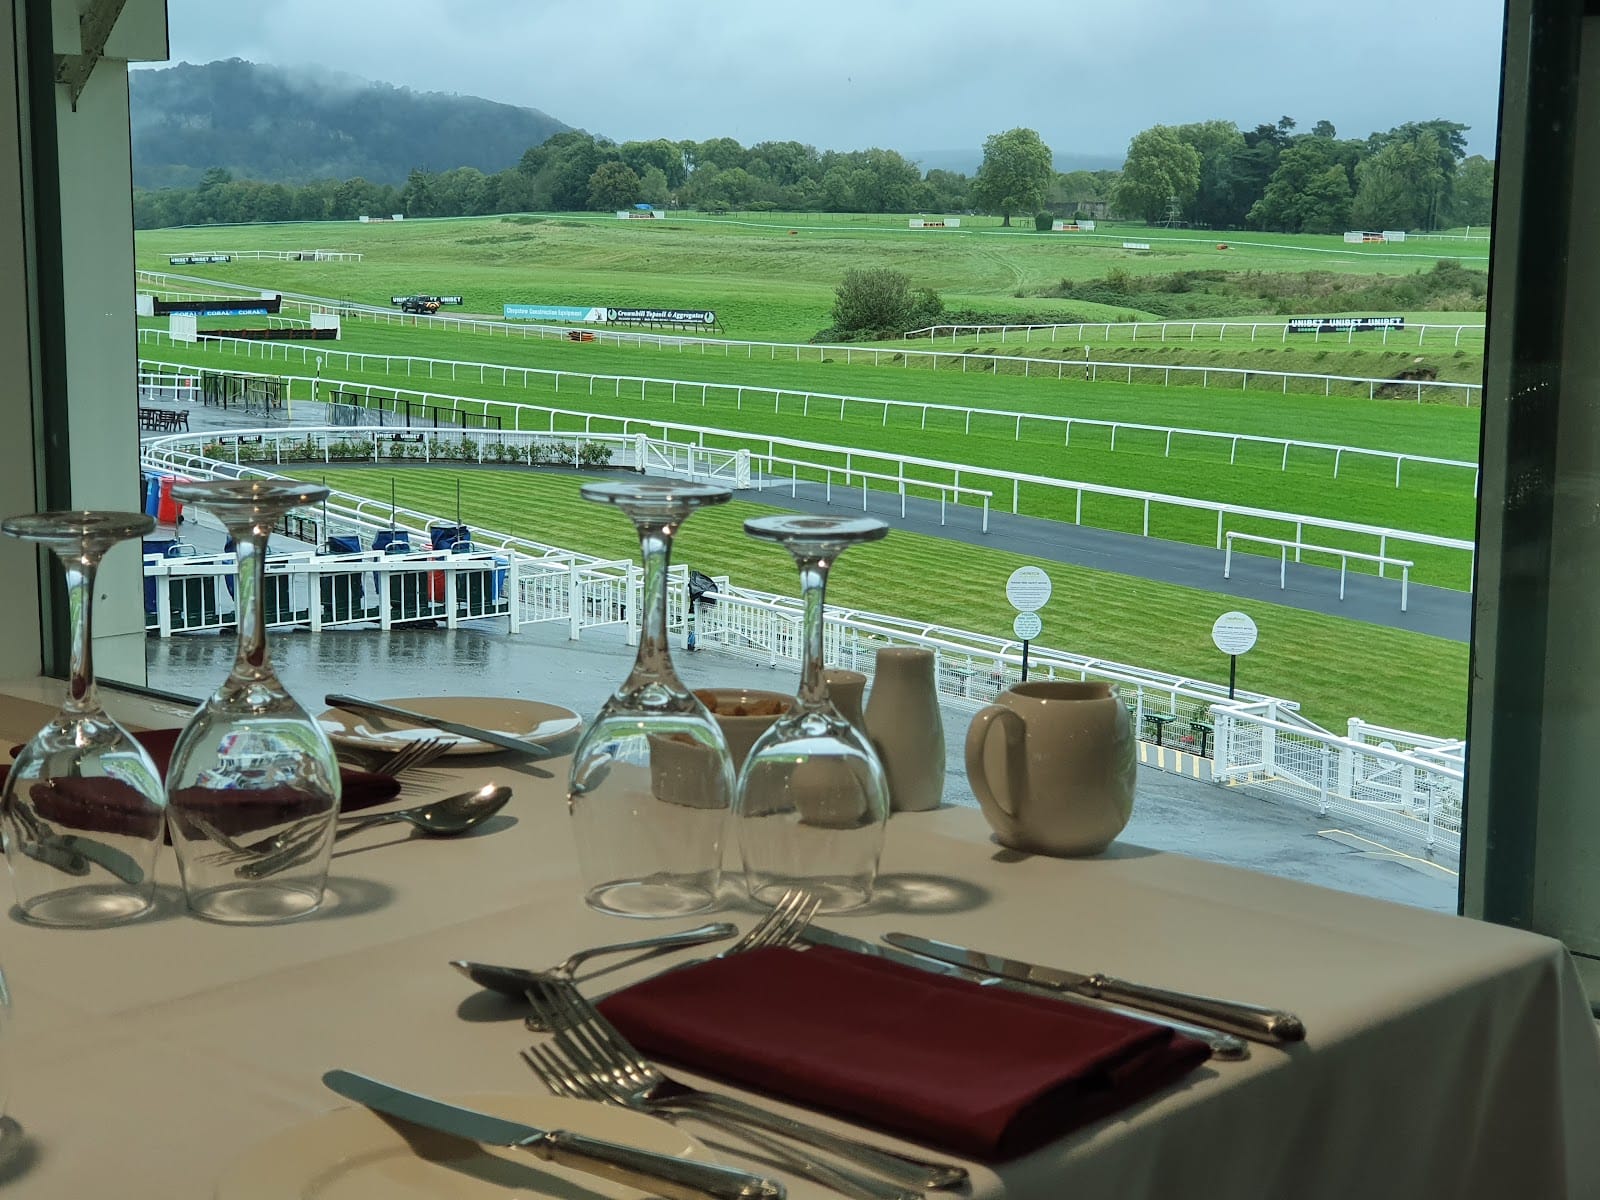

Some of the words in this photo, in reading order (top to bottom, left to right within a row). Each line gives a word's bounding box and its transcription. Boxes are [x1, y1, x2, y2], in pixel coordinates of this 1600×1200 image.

[1291, 319, 1324, 328] UNIBET
[1329, 319, 1362, 327] UNIBET
[1367, 318, 1401, 326] UNIBET
